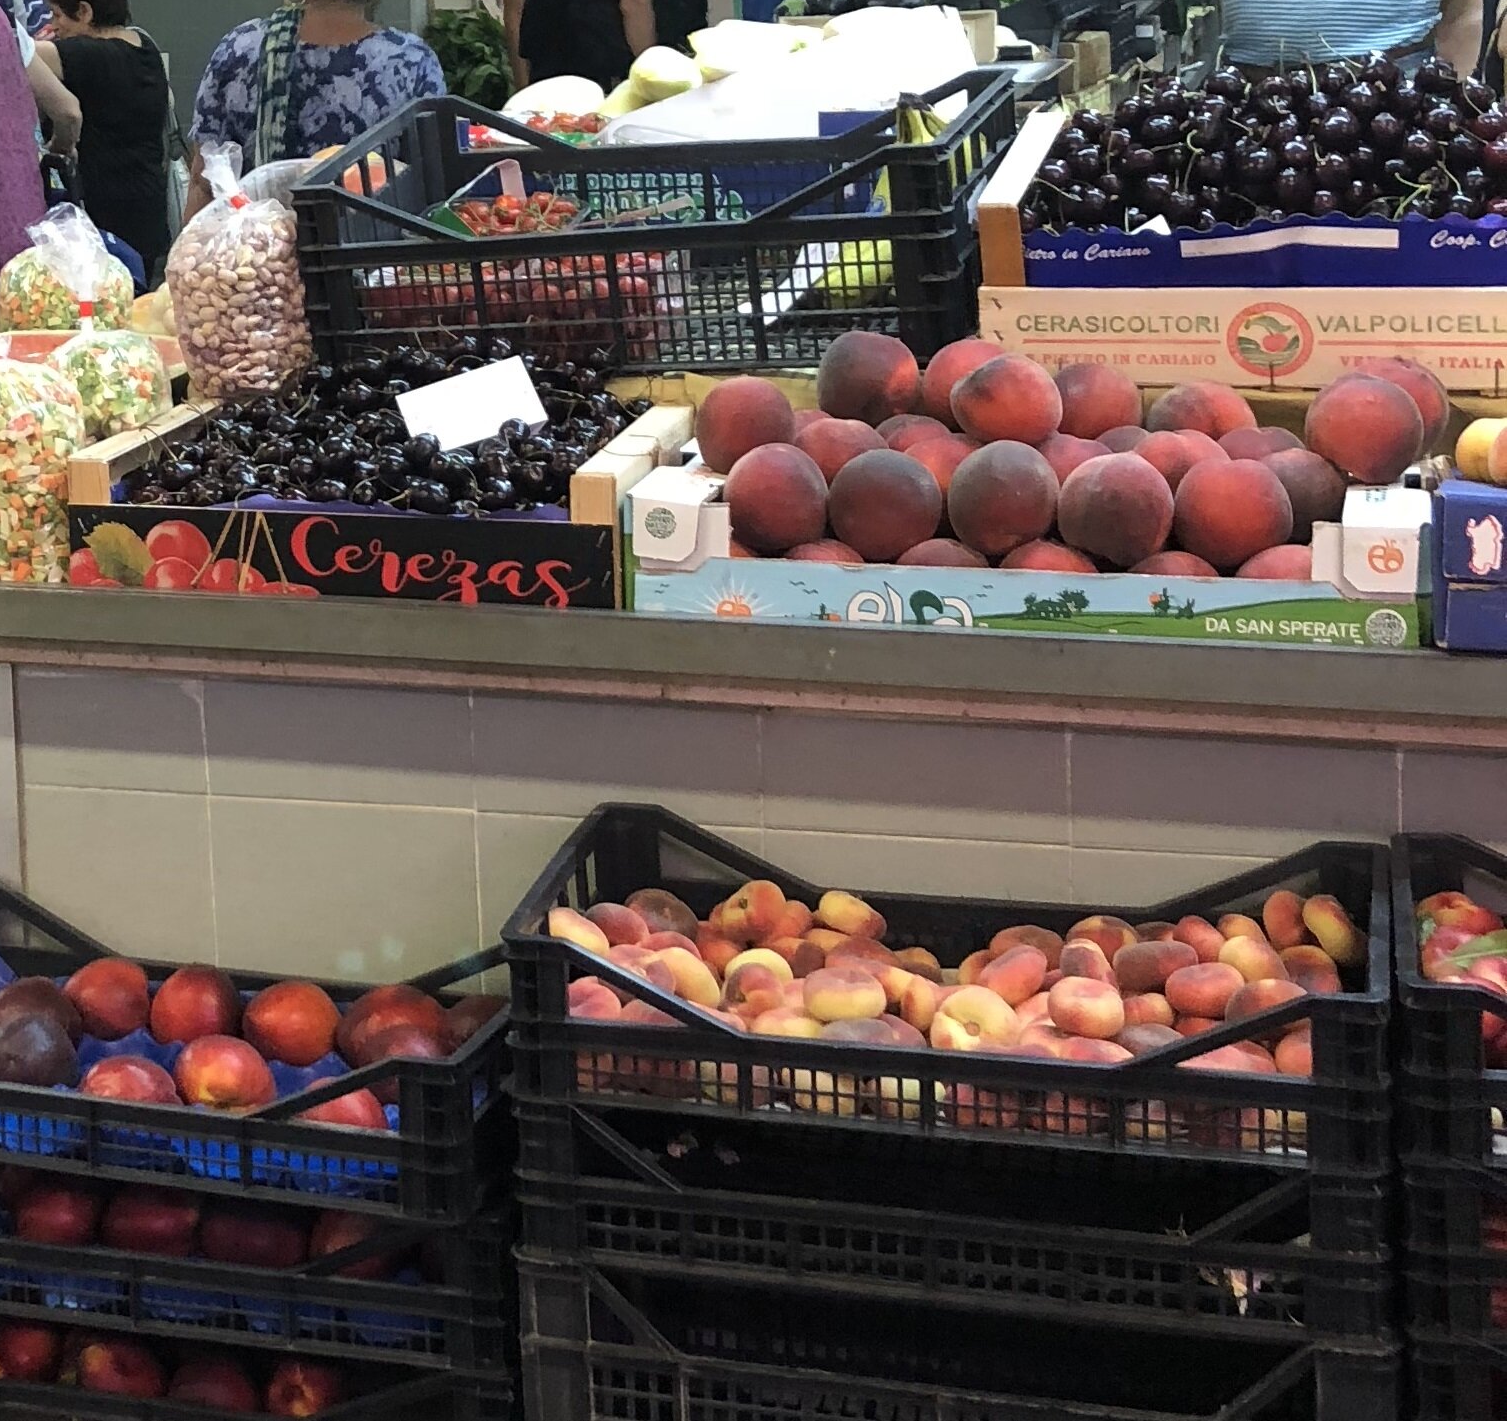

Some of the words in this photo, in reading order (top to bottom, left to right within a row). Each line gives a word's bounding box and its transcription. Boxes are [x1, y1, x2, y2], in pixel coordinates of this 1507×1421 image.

[1430, 229, 1482, 250] Coop.
[1023, 244, 1057, 260] ietro
[1084, 243, 1152, 262] Cariano
[1015, 314, 1220, 334] CERASICOLTORI
[1113, 353, 1131, 365] IN
[1135, 353, 1217, 366] CARIANO
[1439, 356, 1505, 369] ITALIA
[291, 516, 589, 609] Cerezas
[1205, 617, 1230, 633] DA
[1235, 618, 1274, 635] SAN
[1278, 619, 1362, 639] SPERATE
